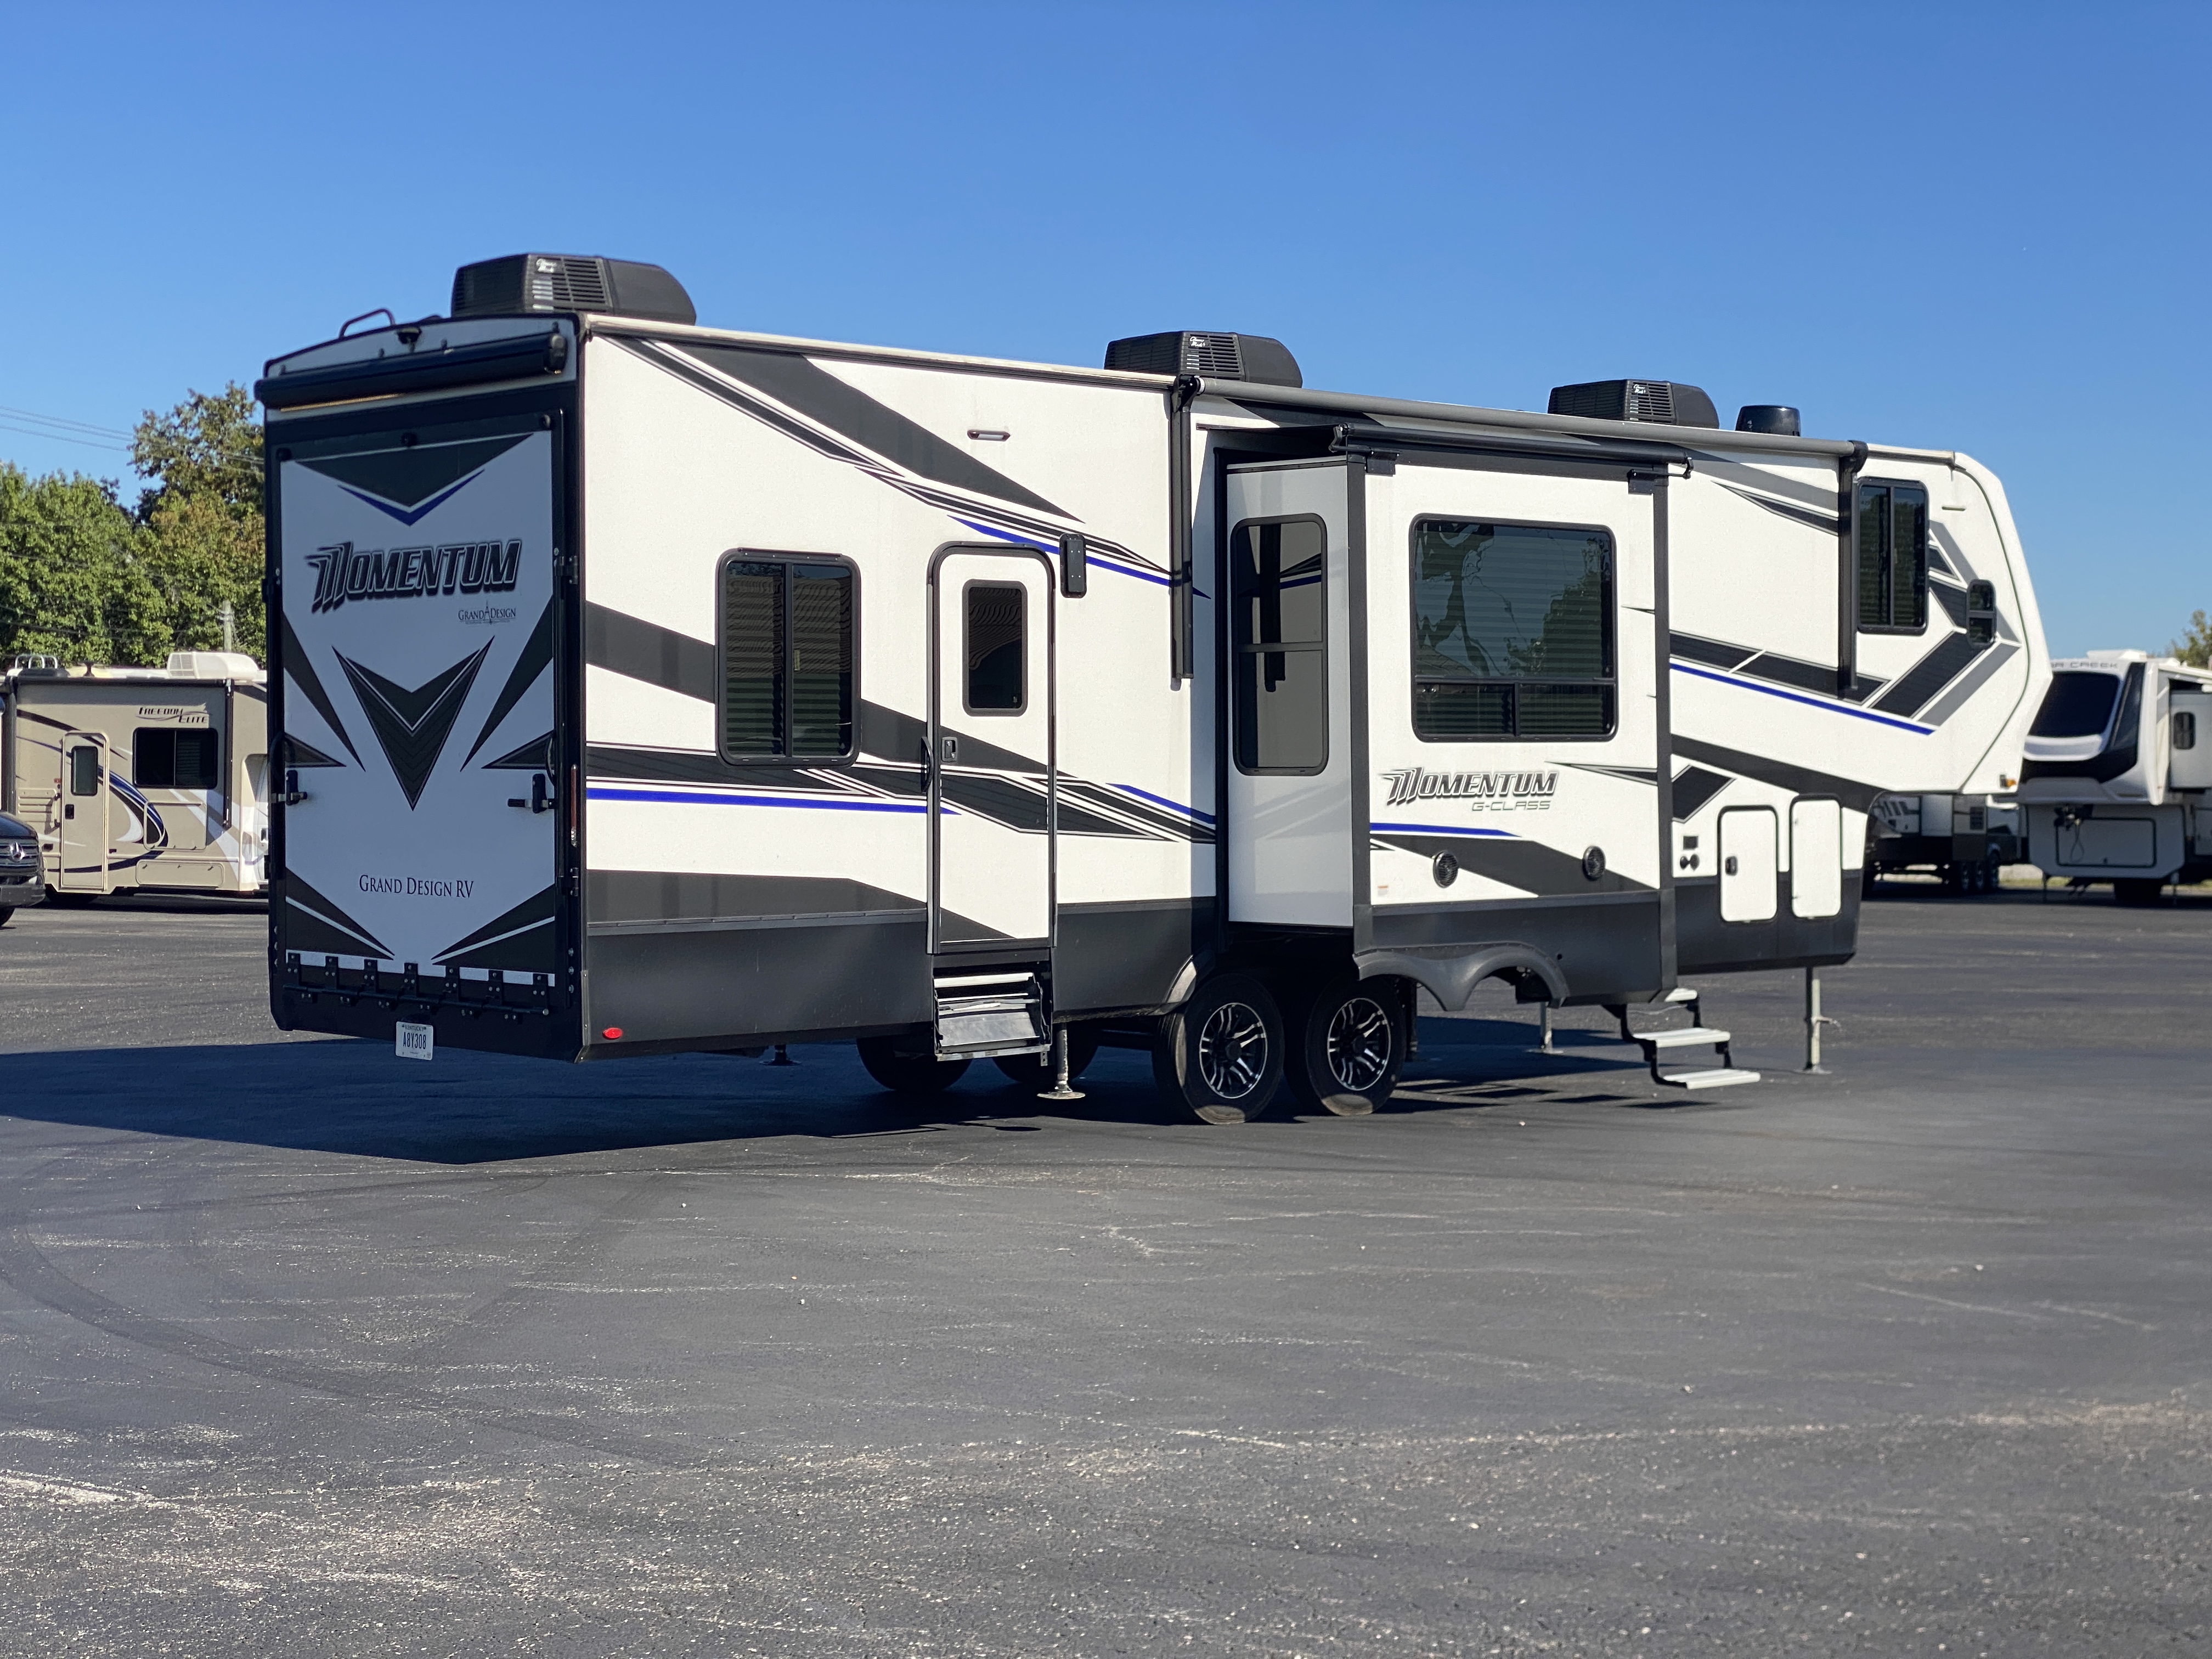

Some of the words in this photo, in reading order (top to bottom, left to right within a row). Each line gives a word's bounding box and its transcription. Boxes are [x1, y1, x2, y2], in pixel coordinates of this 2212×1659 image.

[304, 538, 522, 615] MOMENTUM
[458, 610, 484, 620] GRAND
[490, 607, 516, 618] DESIGN
[139, 707, 183, 715] FREEDOM
[178, 715, 207, 724] ELITE
[1378, 766, 1560, 806] MOMENTUM
[1471, 800, 1551, 811] G-CLASS
[359, 874, 403, 894] GRAND
[407, 877, 452, 897] DESIGN
[456, 879, 474, 898] RV
[403, 1031, 427, 1049] A8Y308
